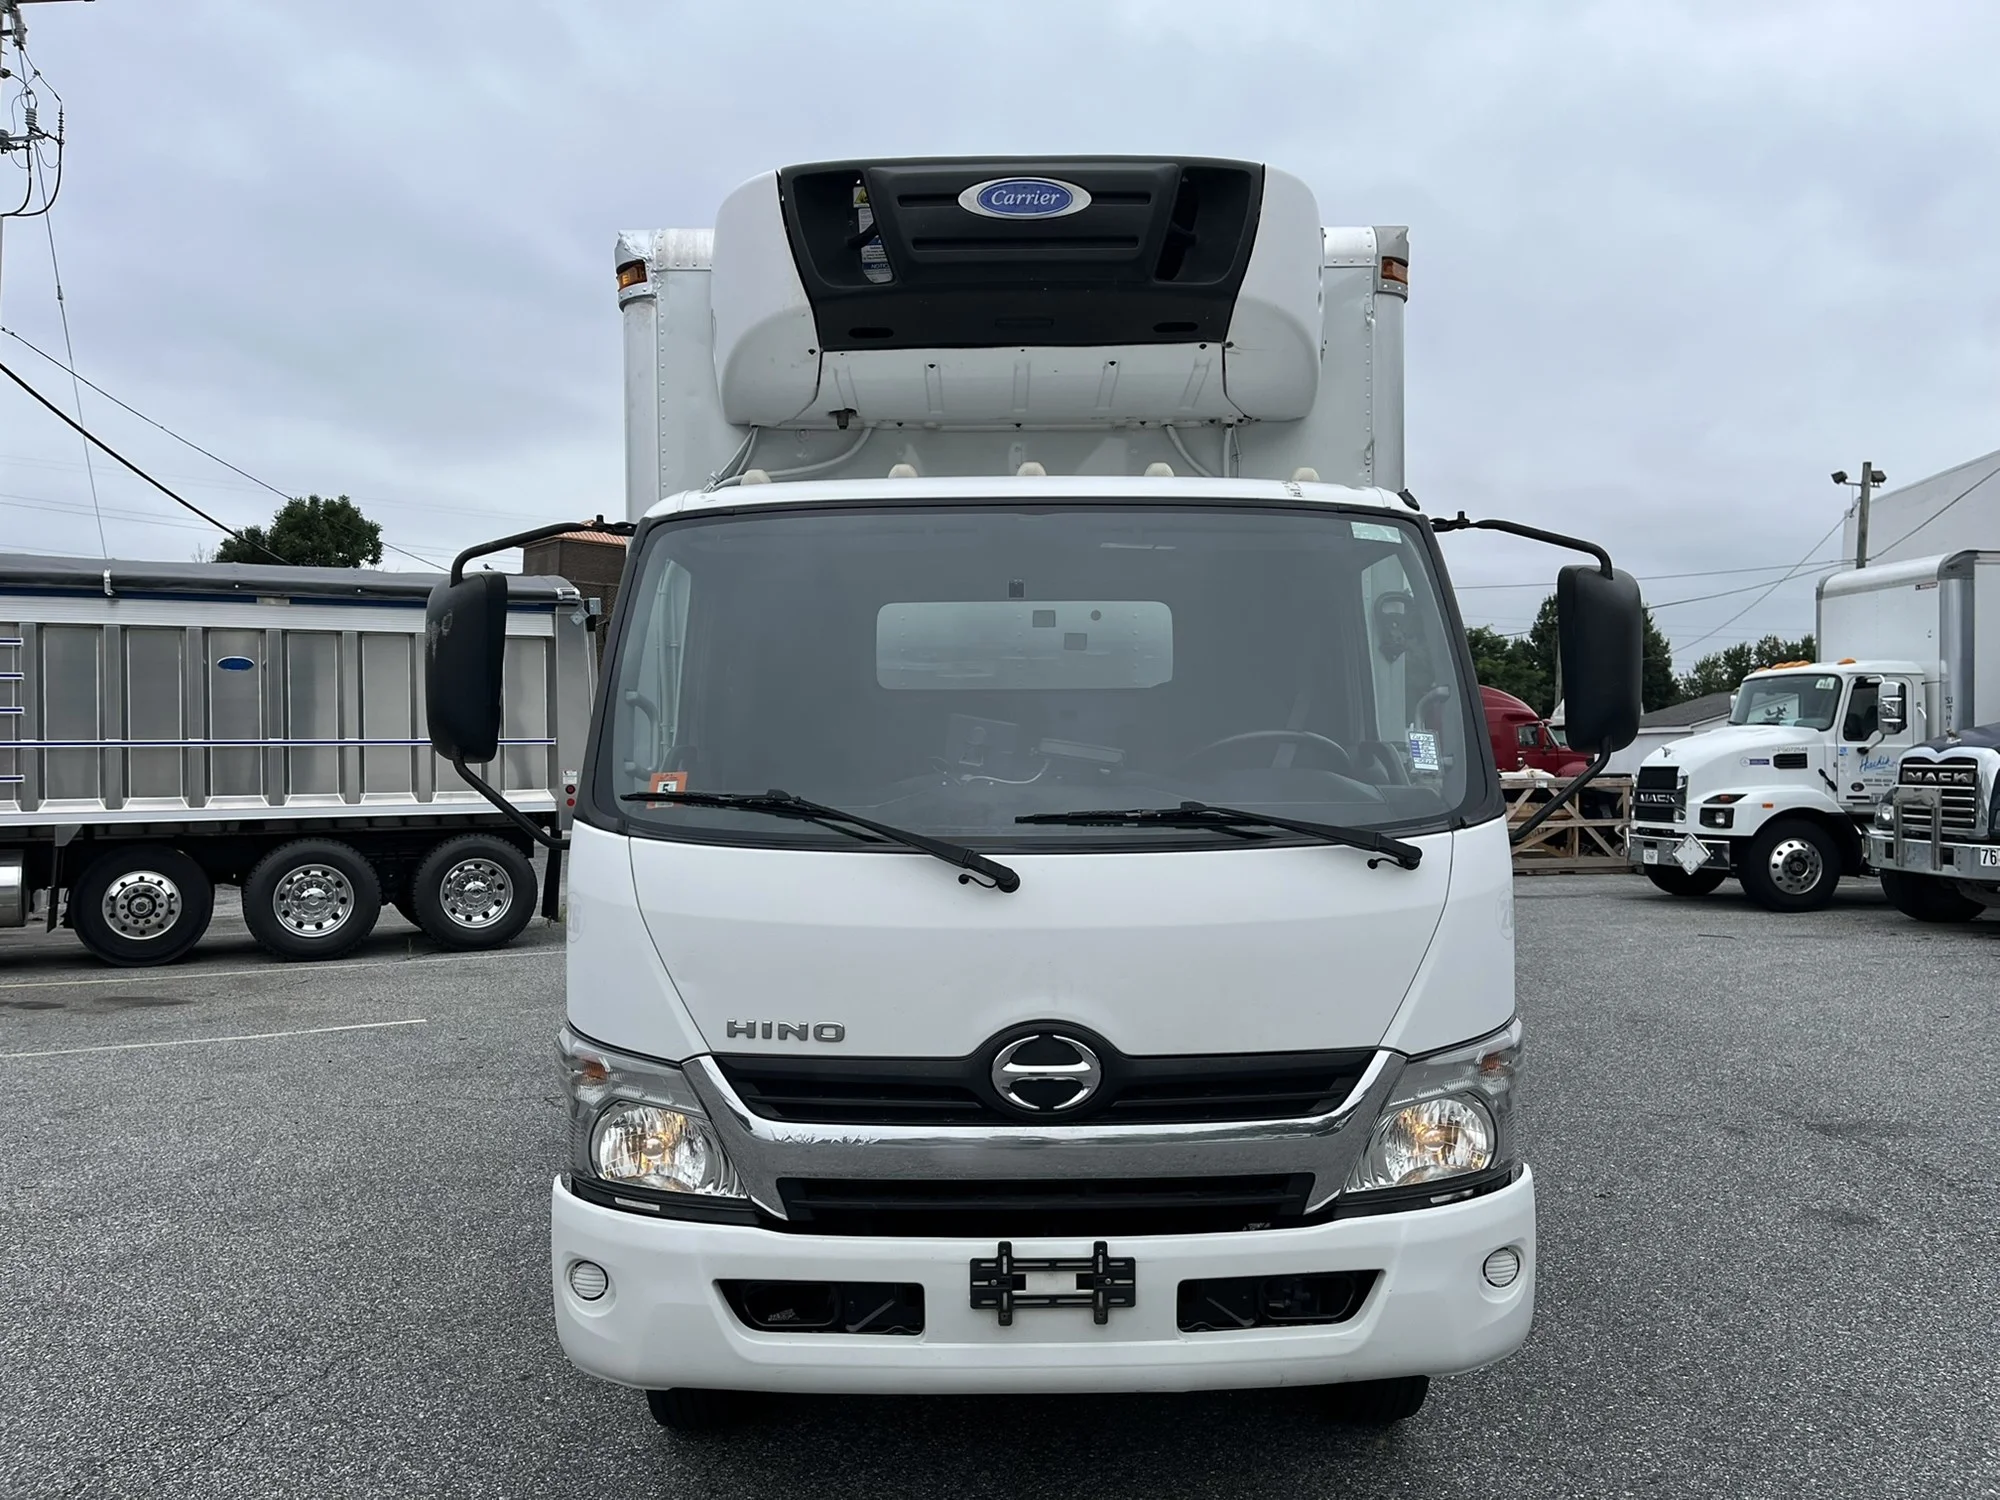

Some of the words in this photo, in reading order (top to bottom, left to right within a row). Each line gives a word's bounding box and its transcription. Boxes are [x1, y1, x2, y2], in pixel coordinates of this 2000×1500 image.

[991, 190, 1060, 205] Carrier
[871, 261, 889, 269] NOTIC
[1907, 771, 1969, 783] MACK
[1640, 793, 1675, 803] MACK
[1981, 848, 1997, 865] 76
[727, 1019, 845, 1043] HINO
